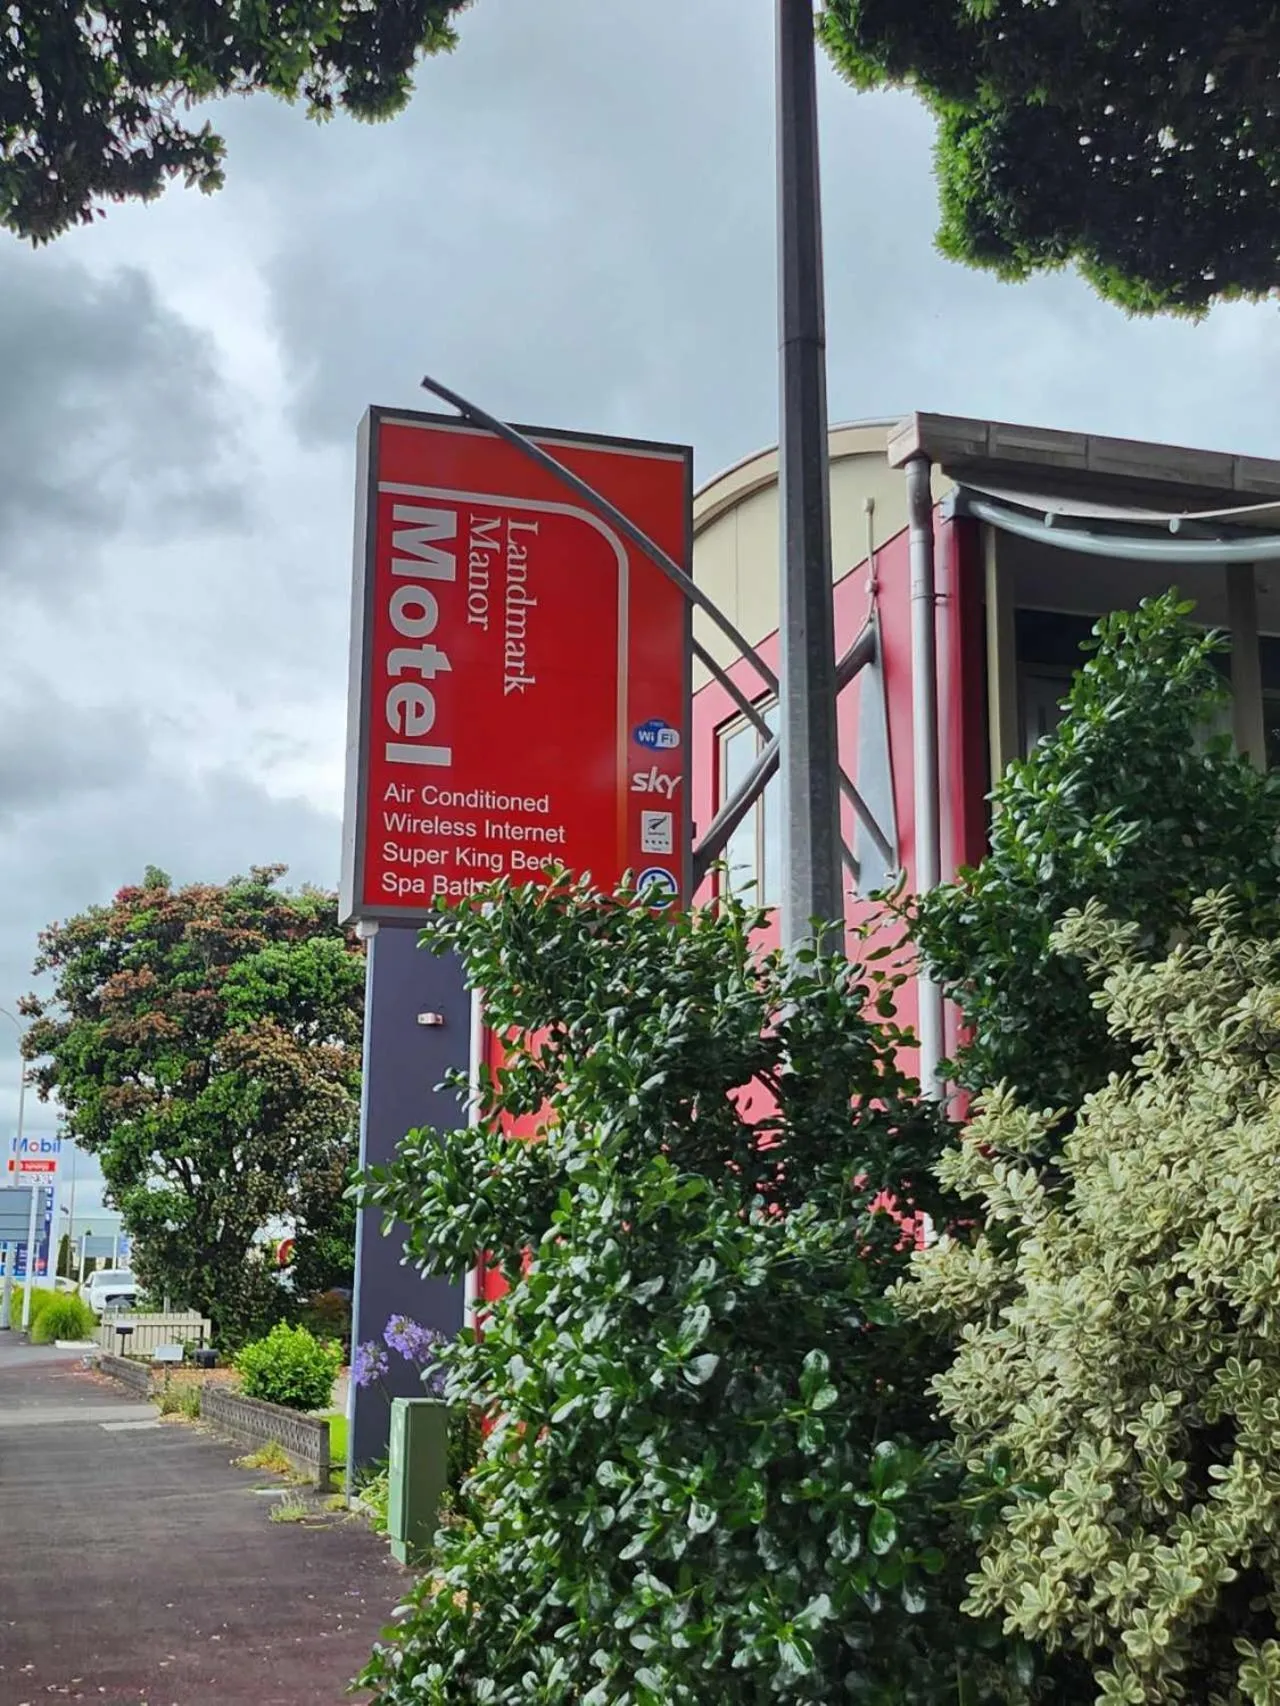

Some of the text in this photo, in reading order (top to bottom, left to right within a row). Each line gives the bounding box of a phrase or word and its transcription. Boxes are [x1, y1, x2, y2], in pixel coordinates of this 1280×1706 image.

[466, 513, 502, 631] Manor
[503, 519, 539, 695] Landmark
[385, 504, 457, 767] Motel
[383, 783, 549, 812] Air Conditioned
[630, 766, 682, 799] sky
[383, 812, 566, 843] Wireless Internet
[382, 841, 449, 867] Super
[455, 846, 504, 872] King
[381, 872, 426, 896] Spa
[12, 1137, 61, 1153] Mobil
